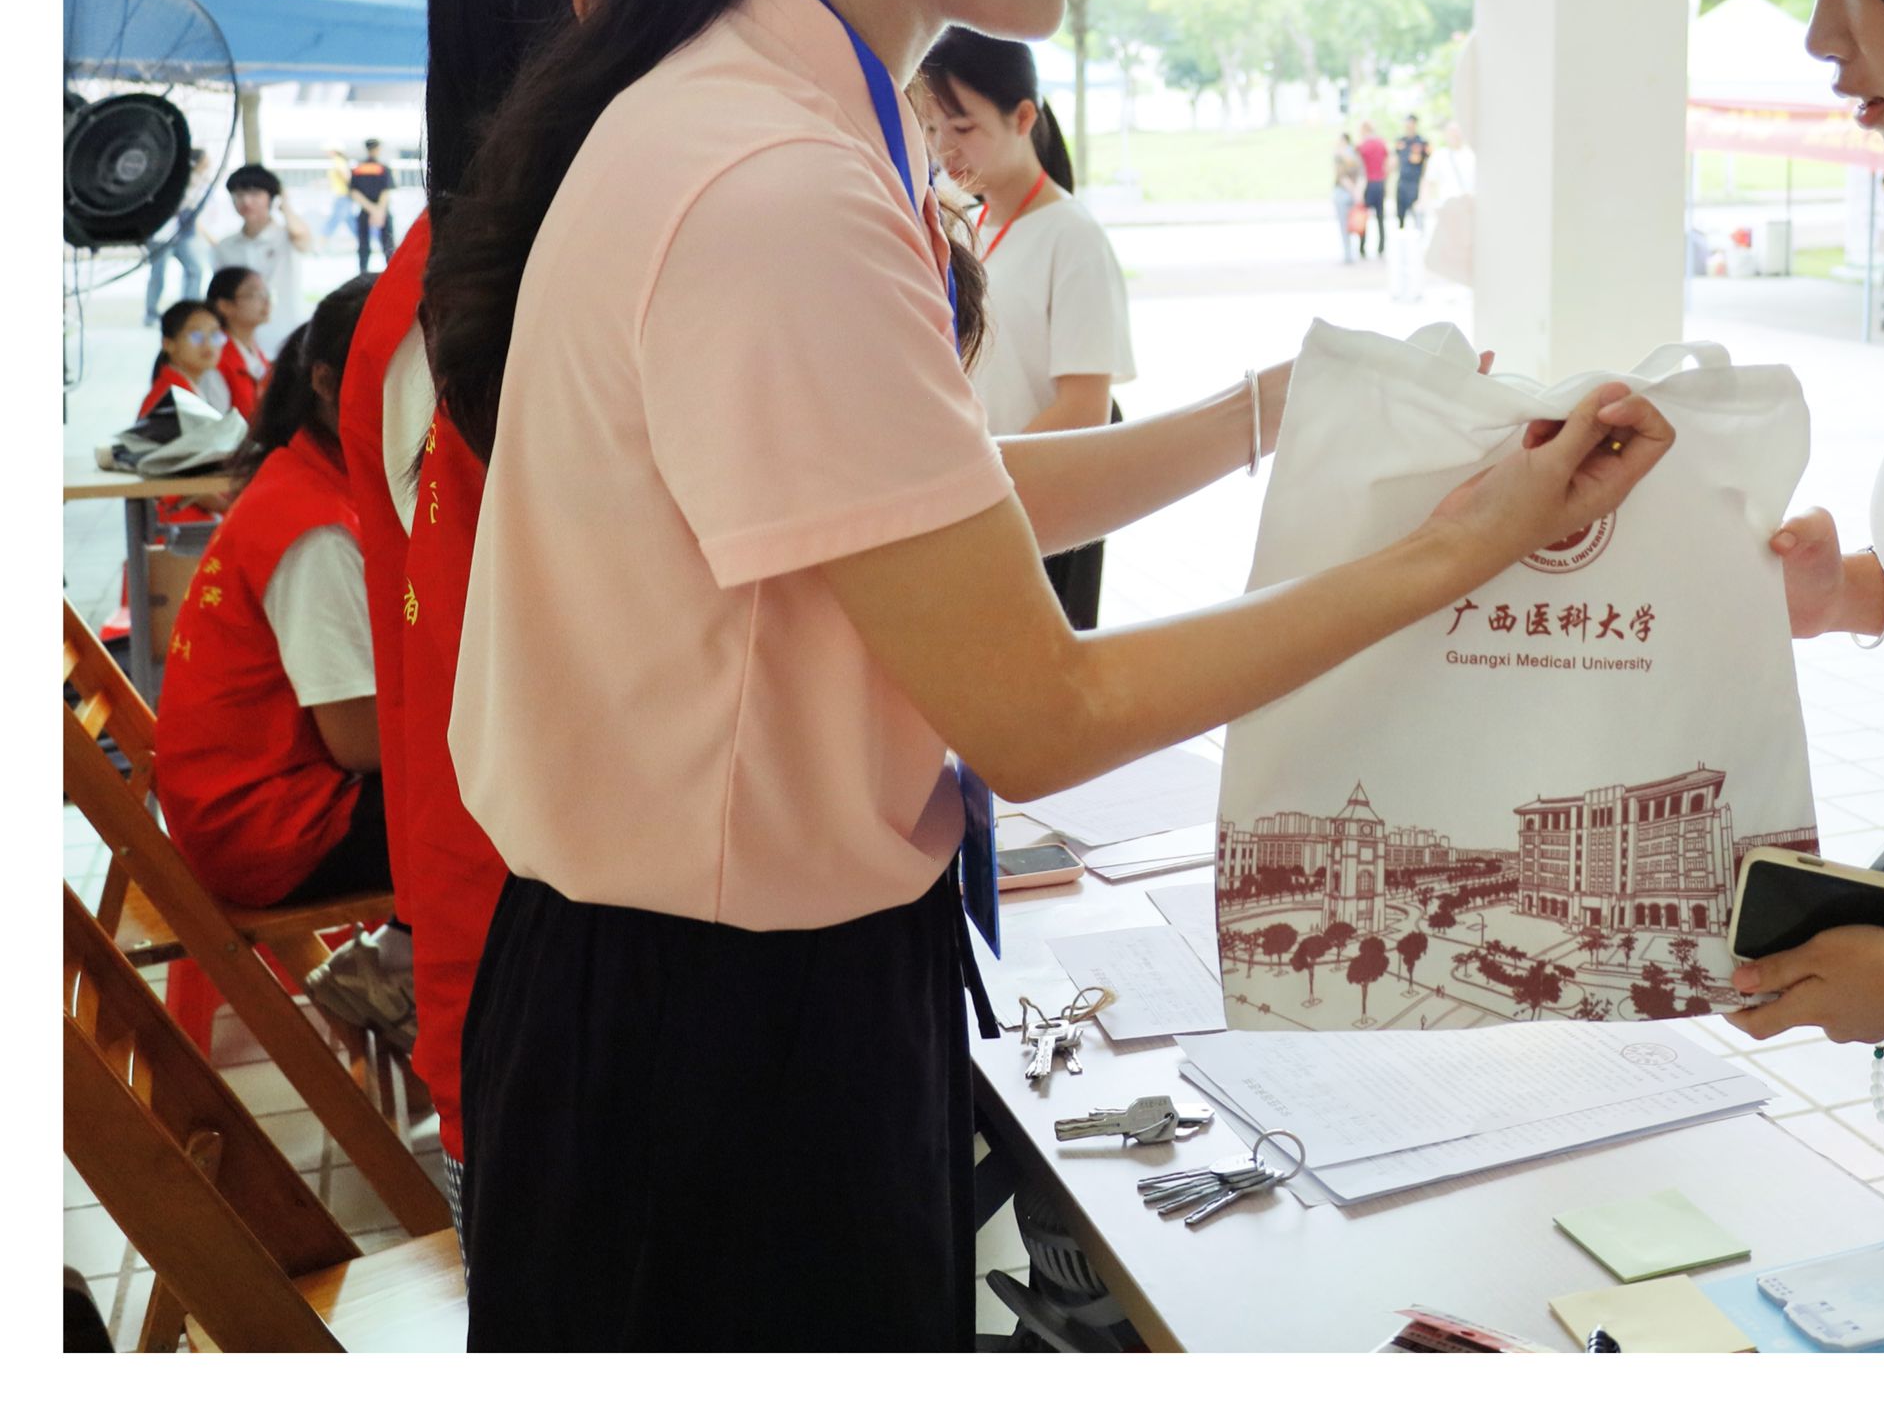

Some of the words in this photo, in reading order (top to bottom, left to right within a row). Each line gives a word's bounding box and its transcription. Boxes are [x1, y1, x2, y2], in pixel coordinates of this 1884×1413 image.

[1447, 598, 1655, 643] 广西医科大学
[1446, 650, 1511, 668] Guangxi
[1516, 653, 1576, 669] Medical
[1582, 657, 1653, 672] University
